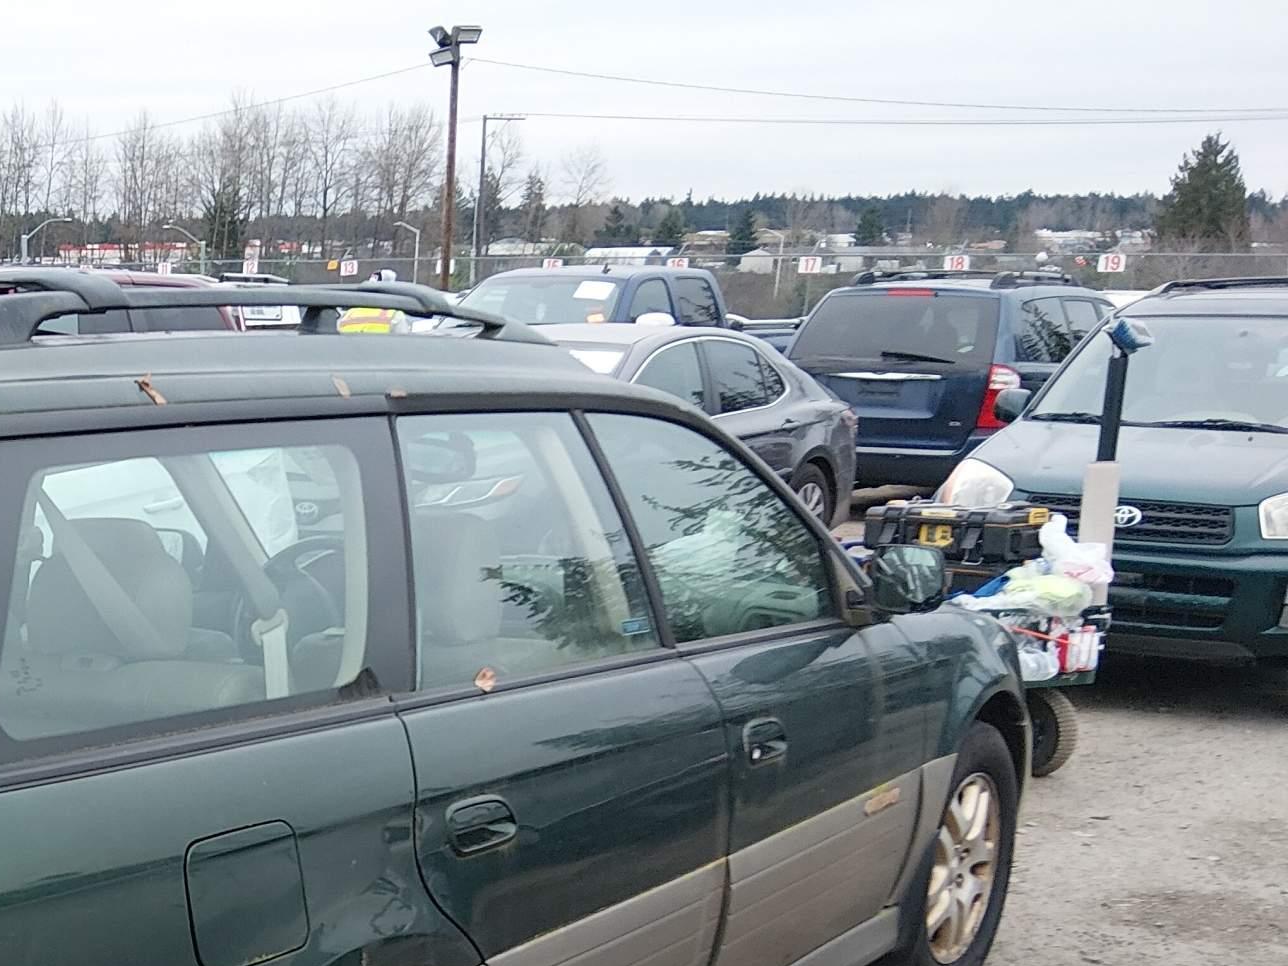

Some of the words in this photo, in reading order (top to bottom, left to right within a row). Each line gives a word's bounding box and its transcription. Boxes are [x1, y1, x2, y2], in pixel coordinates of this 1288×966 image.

[343, 261, 355, 274] 13
[803, 257, 817, 271] 17
[950, 256, 965, 271] 18
[1103, 255, 1121, 271] 19
